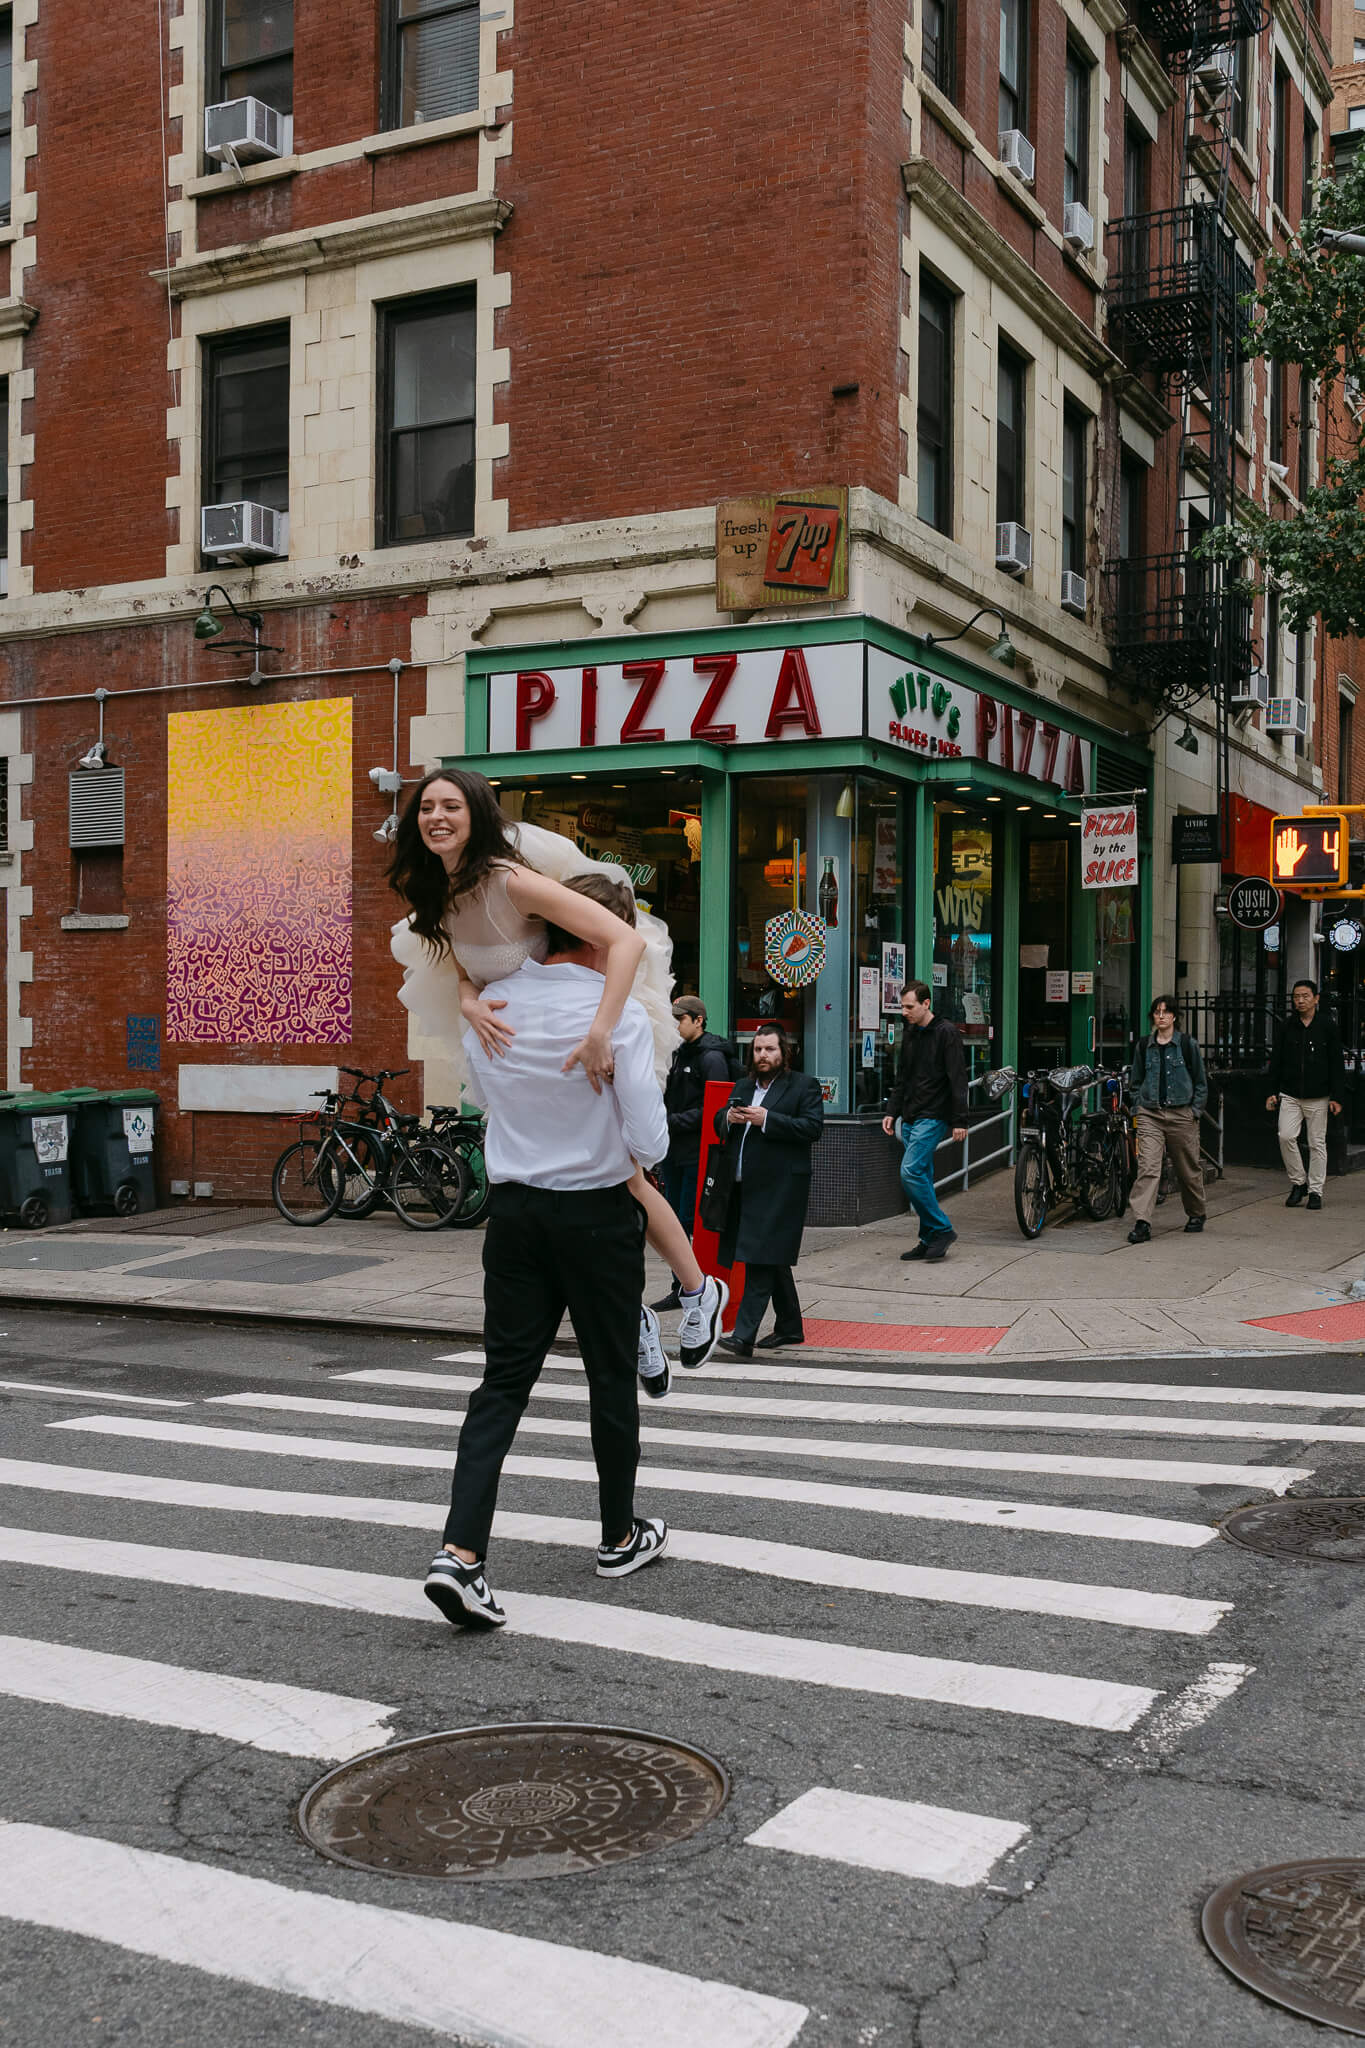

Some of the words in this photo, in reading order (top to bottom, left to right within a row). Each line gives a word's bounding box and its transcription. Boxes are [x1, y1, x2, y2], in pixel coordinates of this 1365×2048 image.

[515, 648, 823, 751] PIZZA
[889, 671, 961, 739] VITO'S
[889, 720, 929, 748] SLICES
[938, 738, 962, 757] ICES
[975, 693, 1085, 794] PIZZA
[1083, 810, 1136, 839] PIZZA
[1093, 843, 1106, 858] by
[1109, 842, 1127, 854] the
[1322, 830, 1340, 872] 4
[1084, 858, 1136, 885] SLICE
[1238, 889, 1270, 909] SUSHI
[1237, 910, 1270, 918] STAR
[863, 1034, 873, 1057] A
[468, 1798, 574, 1810] EDISON
